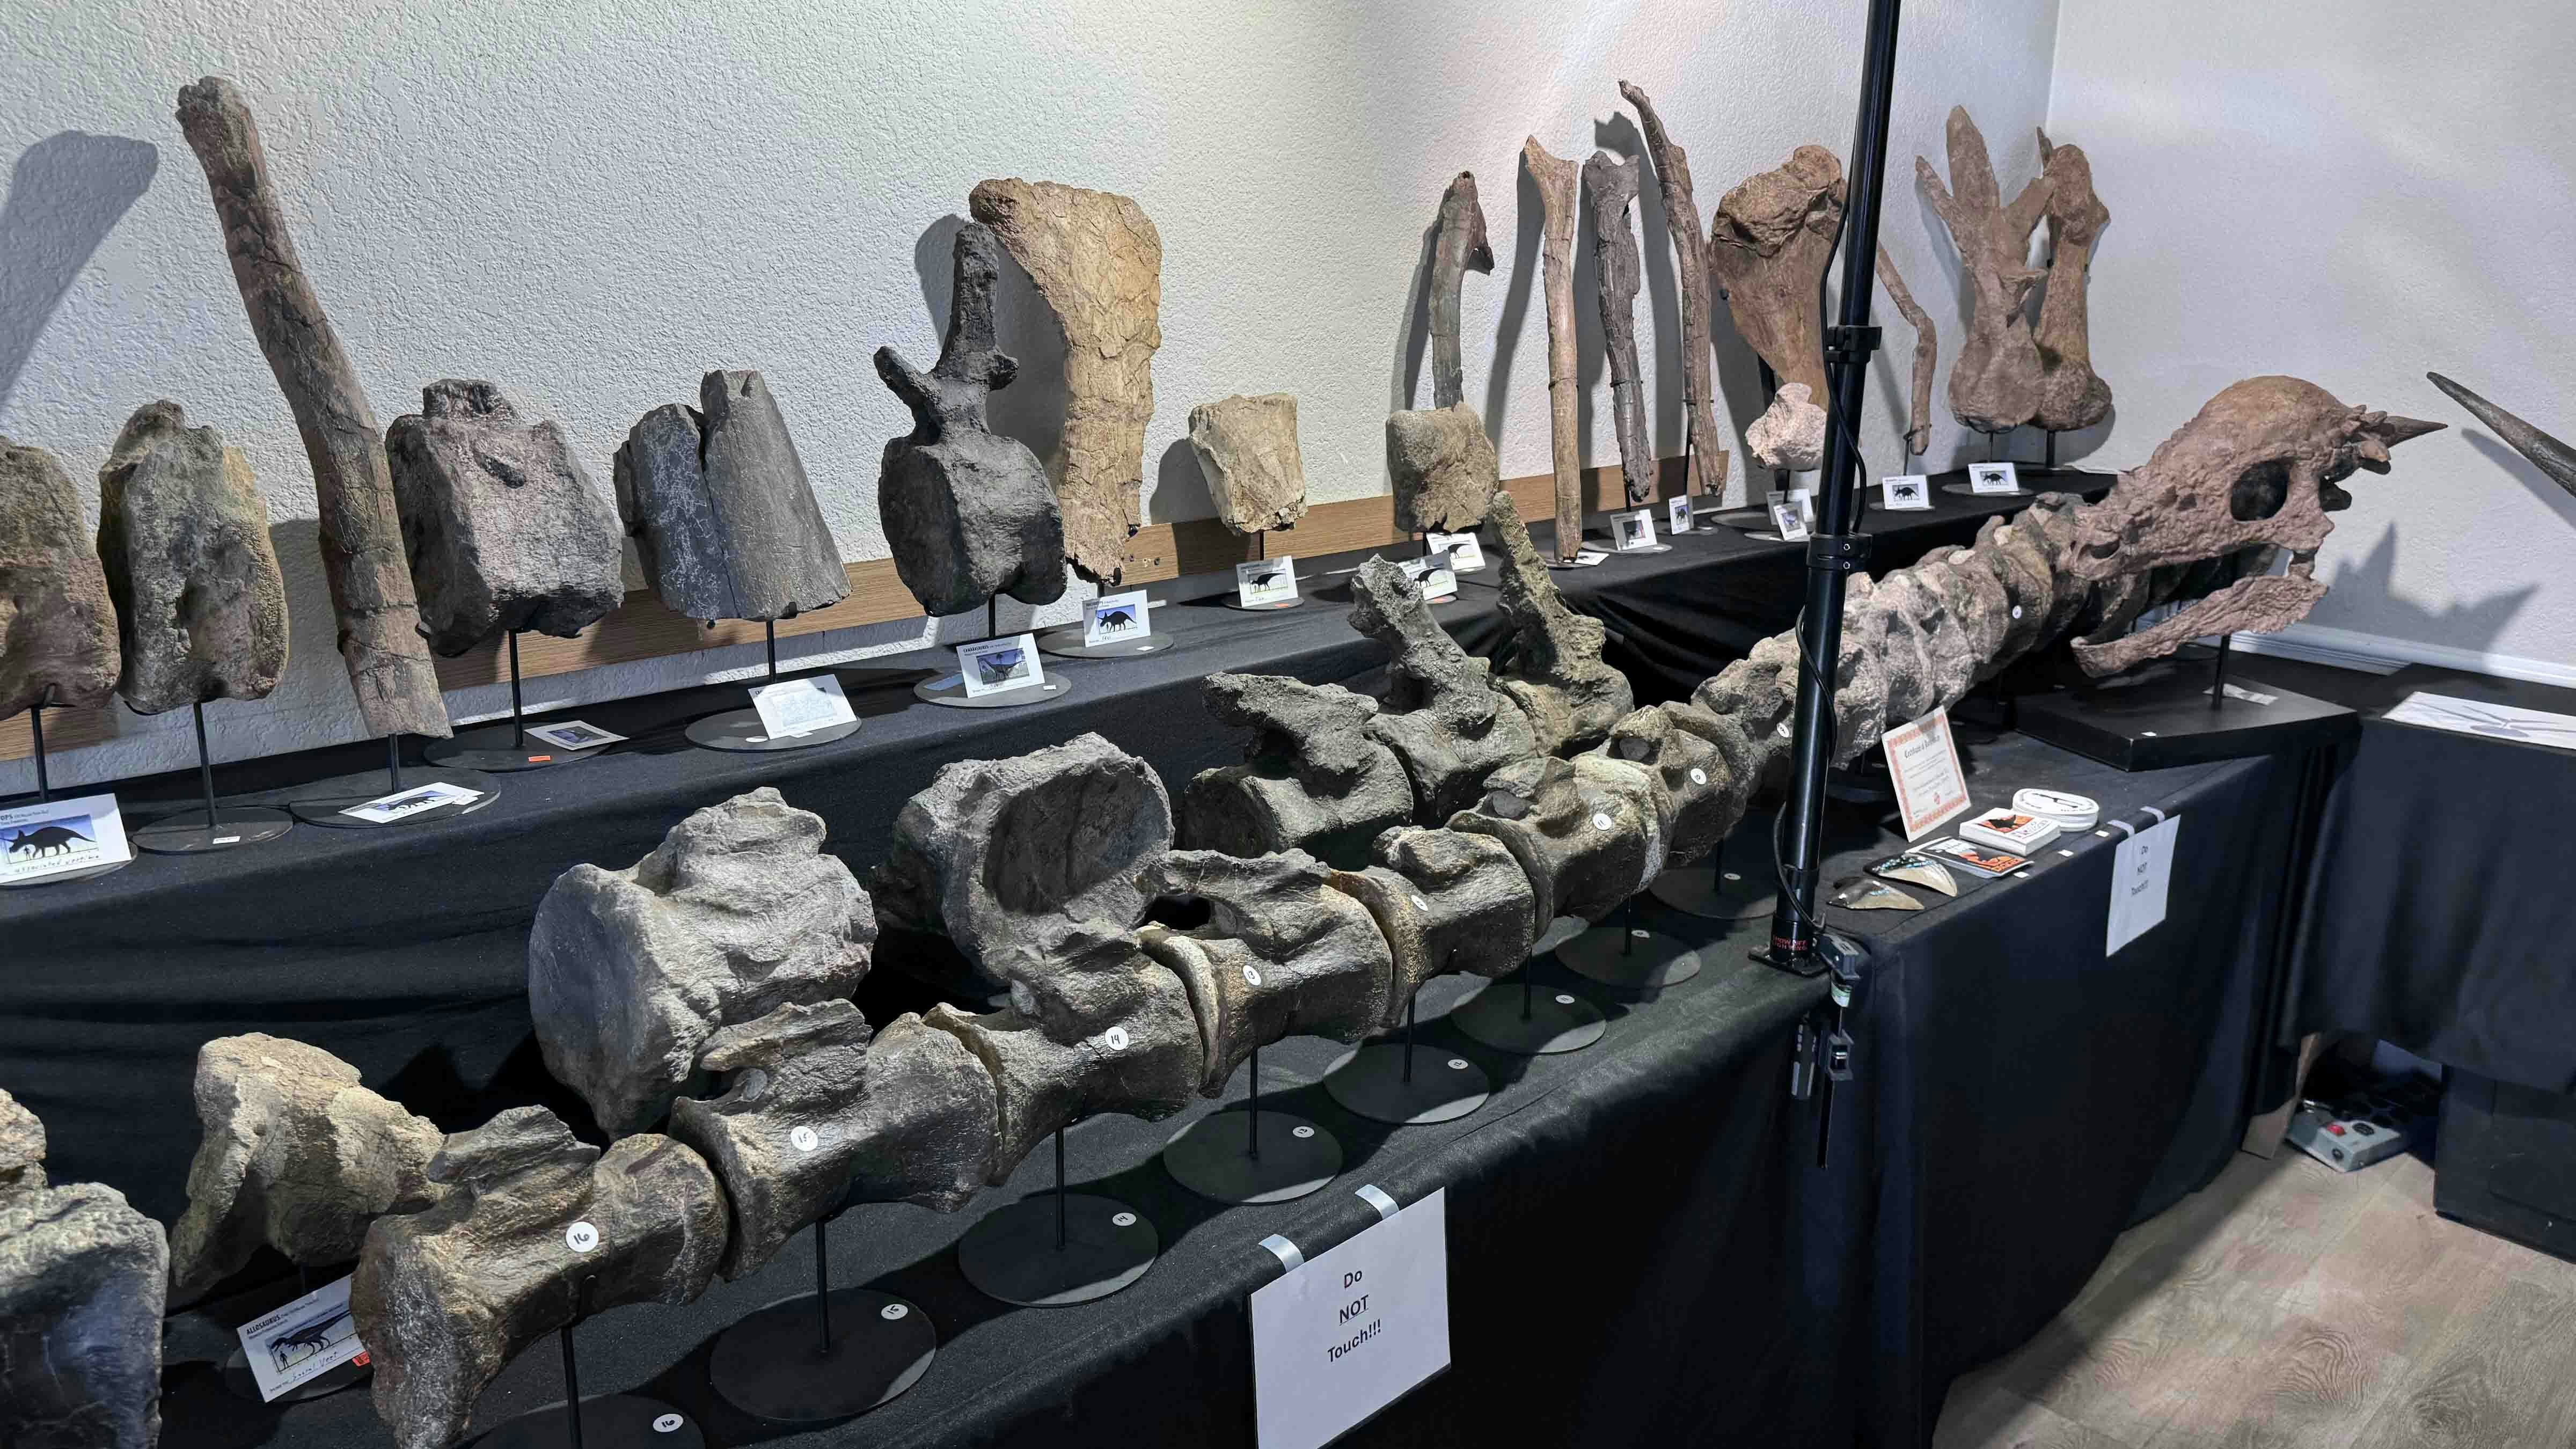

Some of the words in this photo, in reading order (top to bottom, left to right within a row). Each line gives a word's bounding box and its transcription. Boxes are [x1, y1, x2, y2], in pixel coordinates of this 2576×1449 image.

[1110, 1034, 1121, 1044] 14
[573, 1232, 590, 1245] 16
[1343, 1269, 1363, 1289] Do
[1338, 1294, 1369, 1324] NOT
[246, 1314, 281, 1335] ALLOSAURUS
[1327, 1319, 1382, 1363] Touch!!!
[661, 1419, 676, 1428] 16
